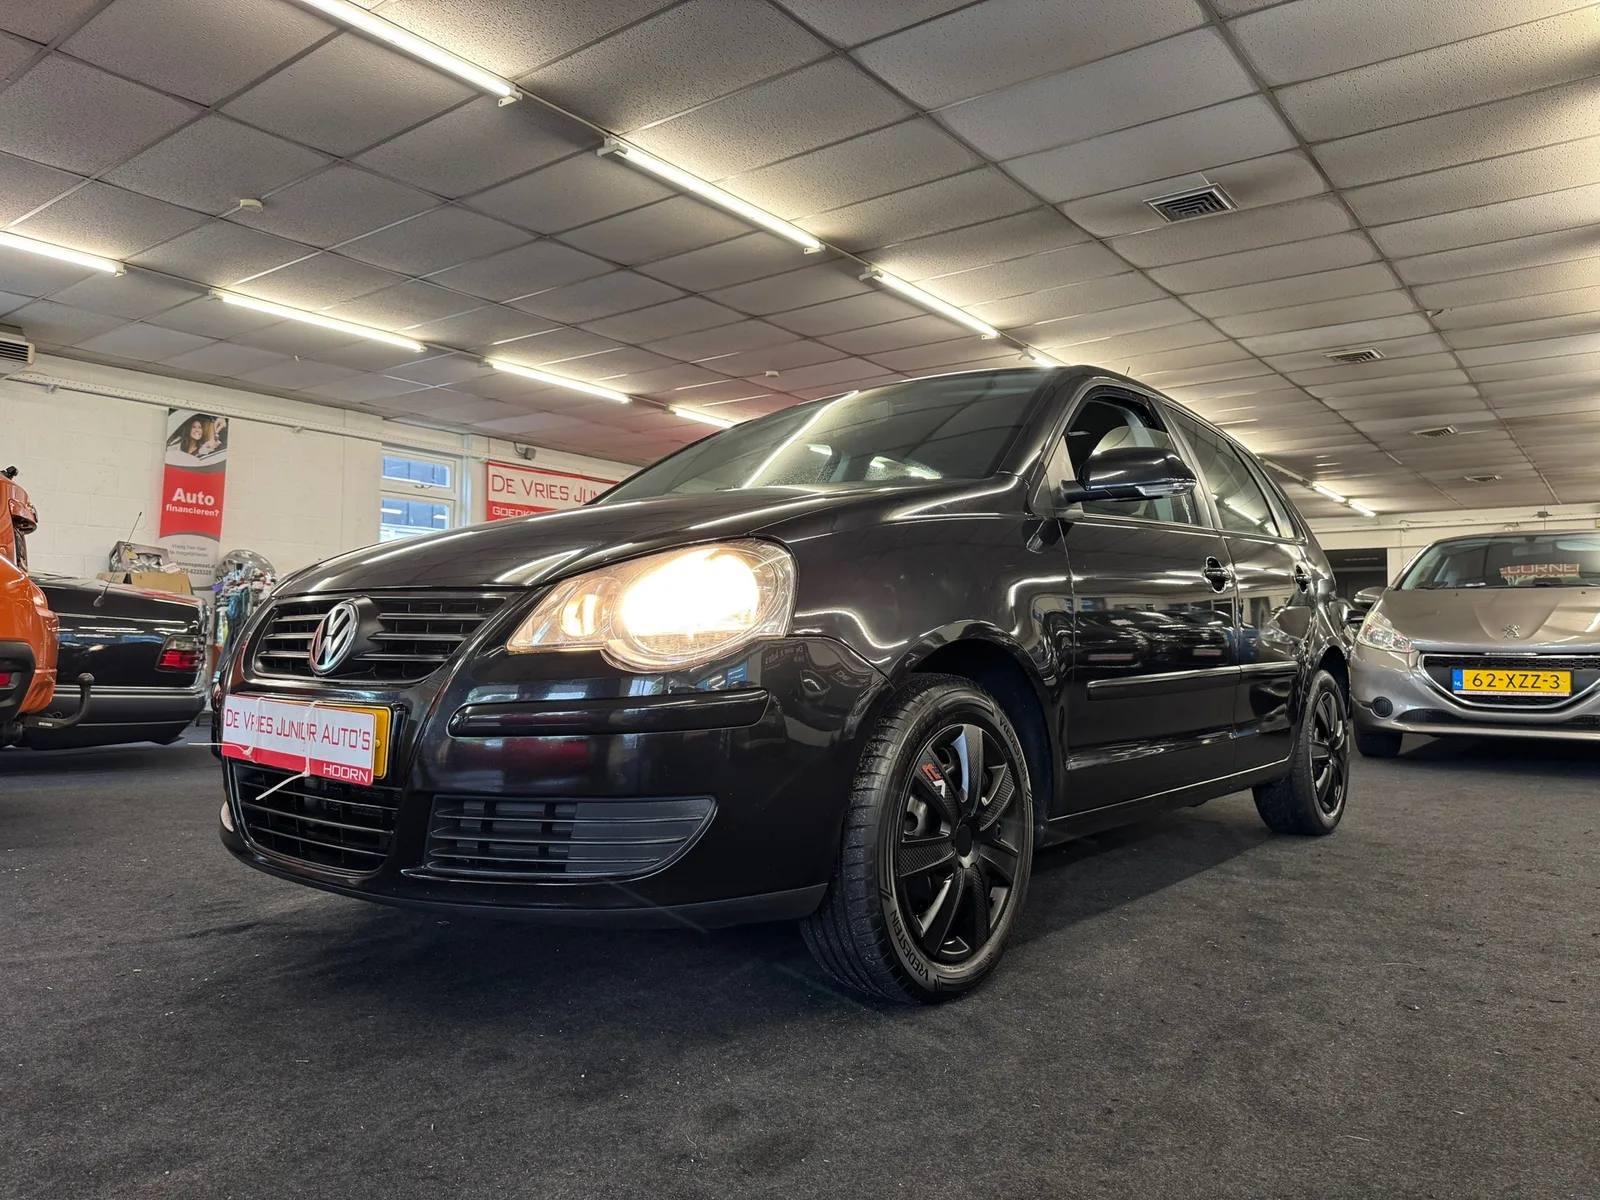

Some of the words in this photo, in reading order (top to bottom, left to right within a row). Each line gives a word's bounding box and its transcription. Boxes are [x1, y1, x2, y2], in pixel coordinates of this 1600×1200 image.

[172, 487, 215, 506] Auto
[491, 474, 516, 494] DE
[521, 479, 569, 501] VRIES
[166, 503, 220, 517] financieren?
[1472, 673, 1560, 689] 62-XZZ-3
[225, 709, 239, 728] DE
[321, 724, 371, 750] AUTO'S
[323, 763, 369, 783] HOORN
[890, 910, 928, 981] VREDESTEIN
